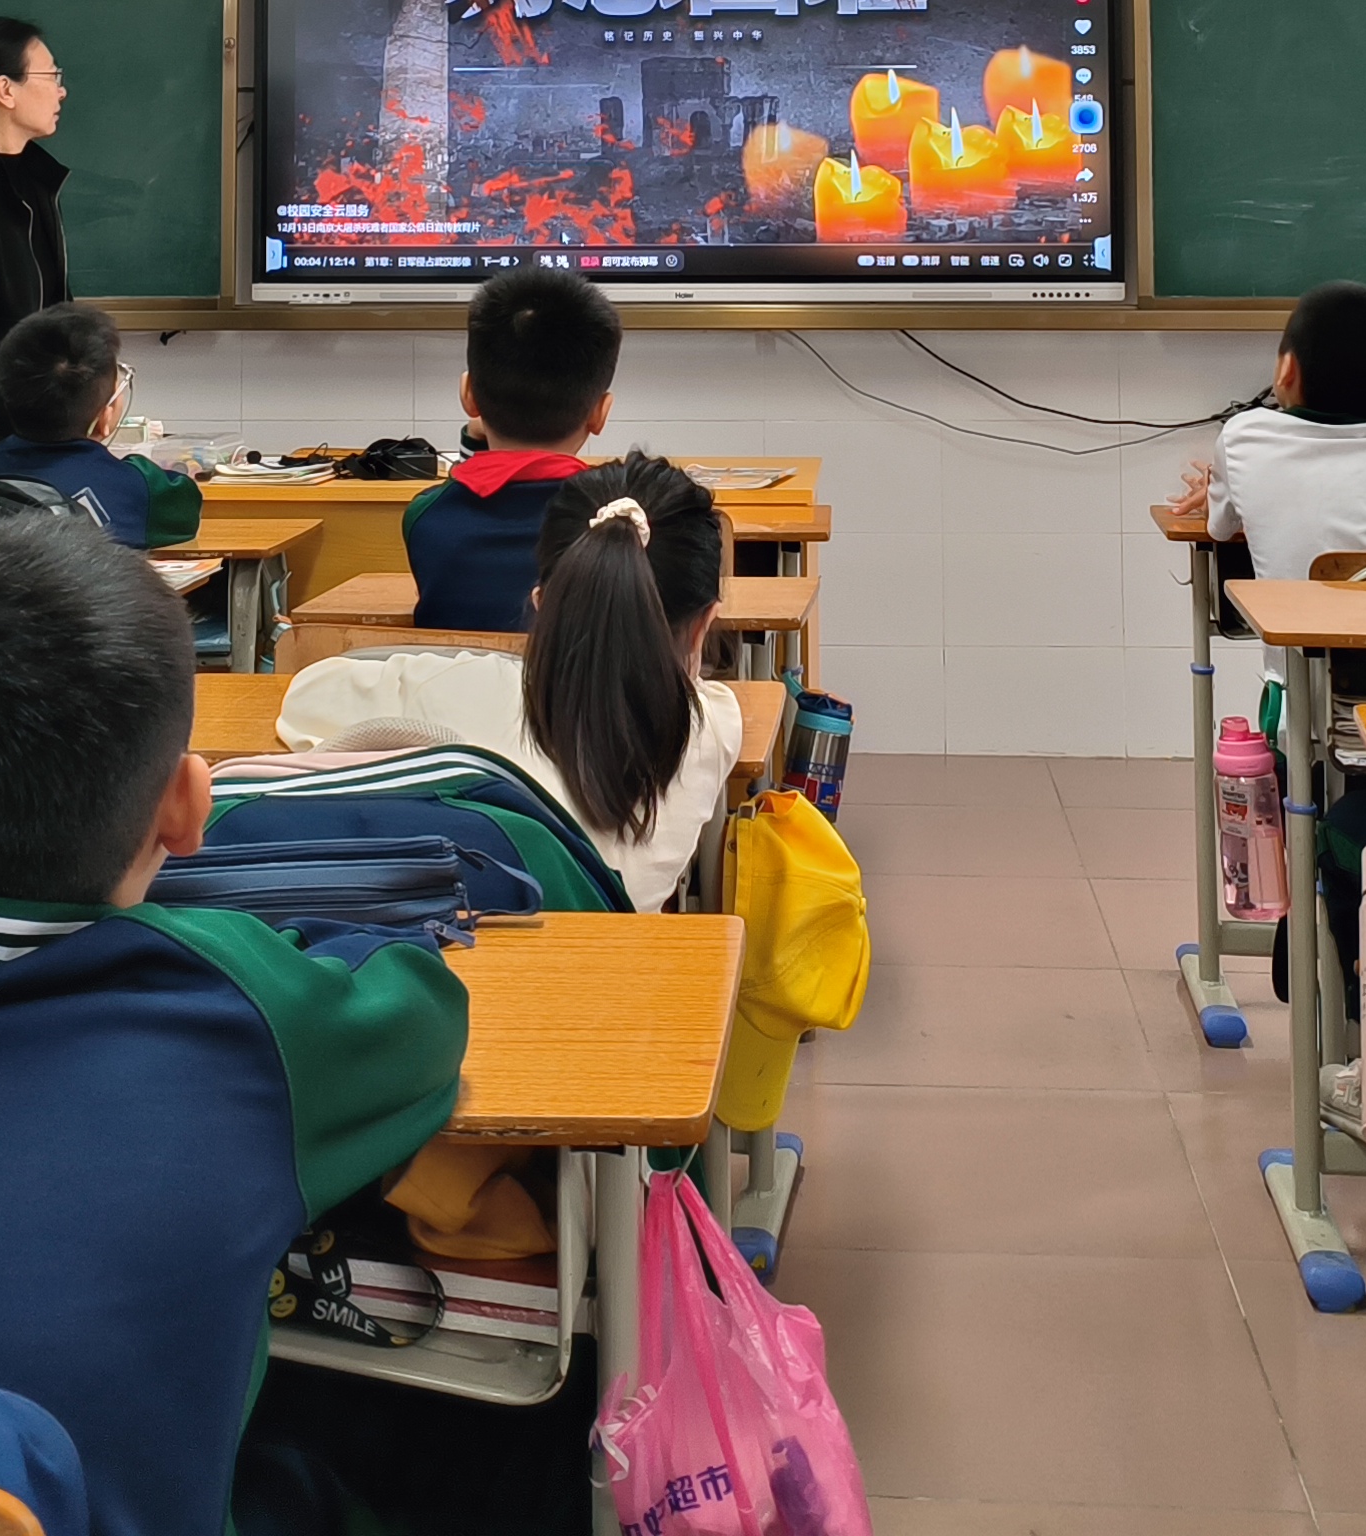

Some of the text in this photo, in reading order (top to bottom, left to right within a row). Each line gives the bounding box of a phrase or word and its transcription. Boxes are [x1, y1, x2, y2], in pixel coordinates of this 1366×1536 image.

[1071, 44, 1097, 55] 3853
[1072, 192, 1098, 204] 1.3万
[294, 256, 322, 267] 00:04
[328, 256, 356, 267] 12:14
[311, 1297, 378, 1339] SMILE
